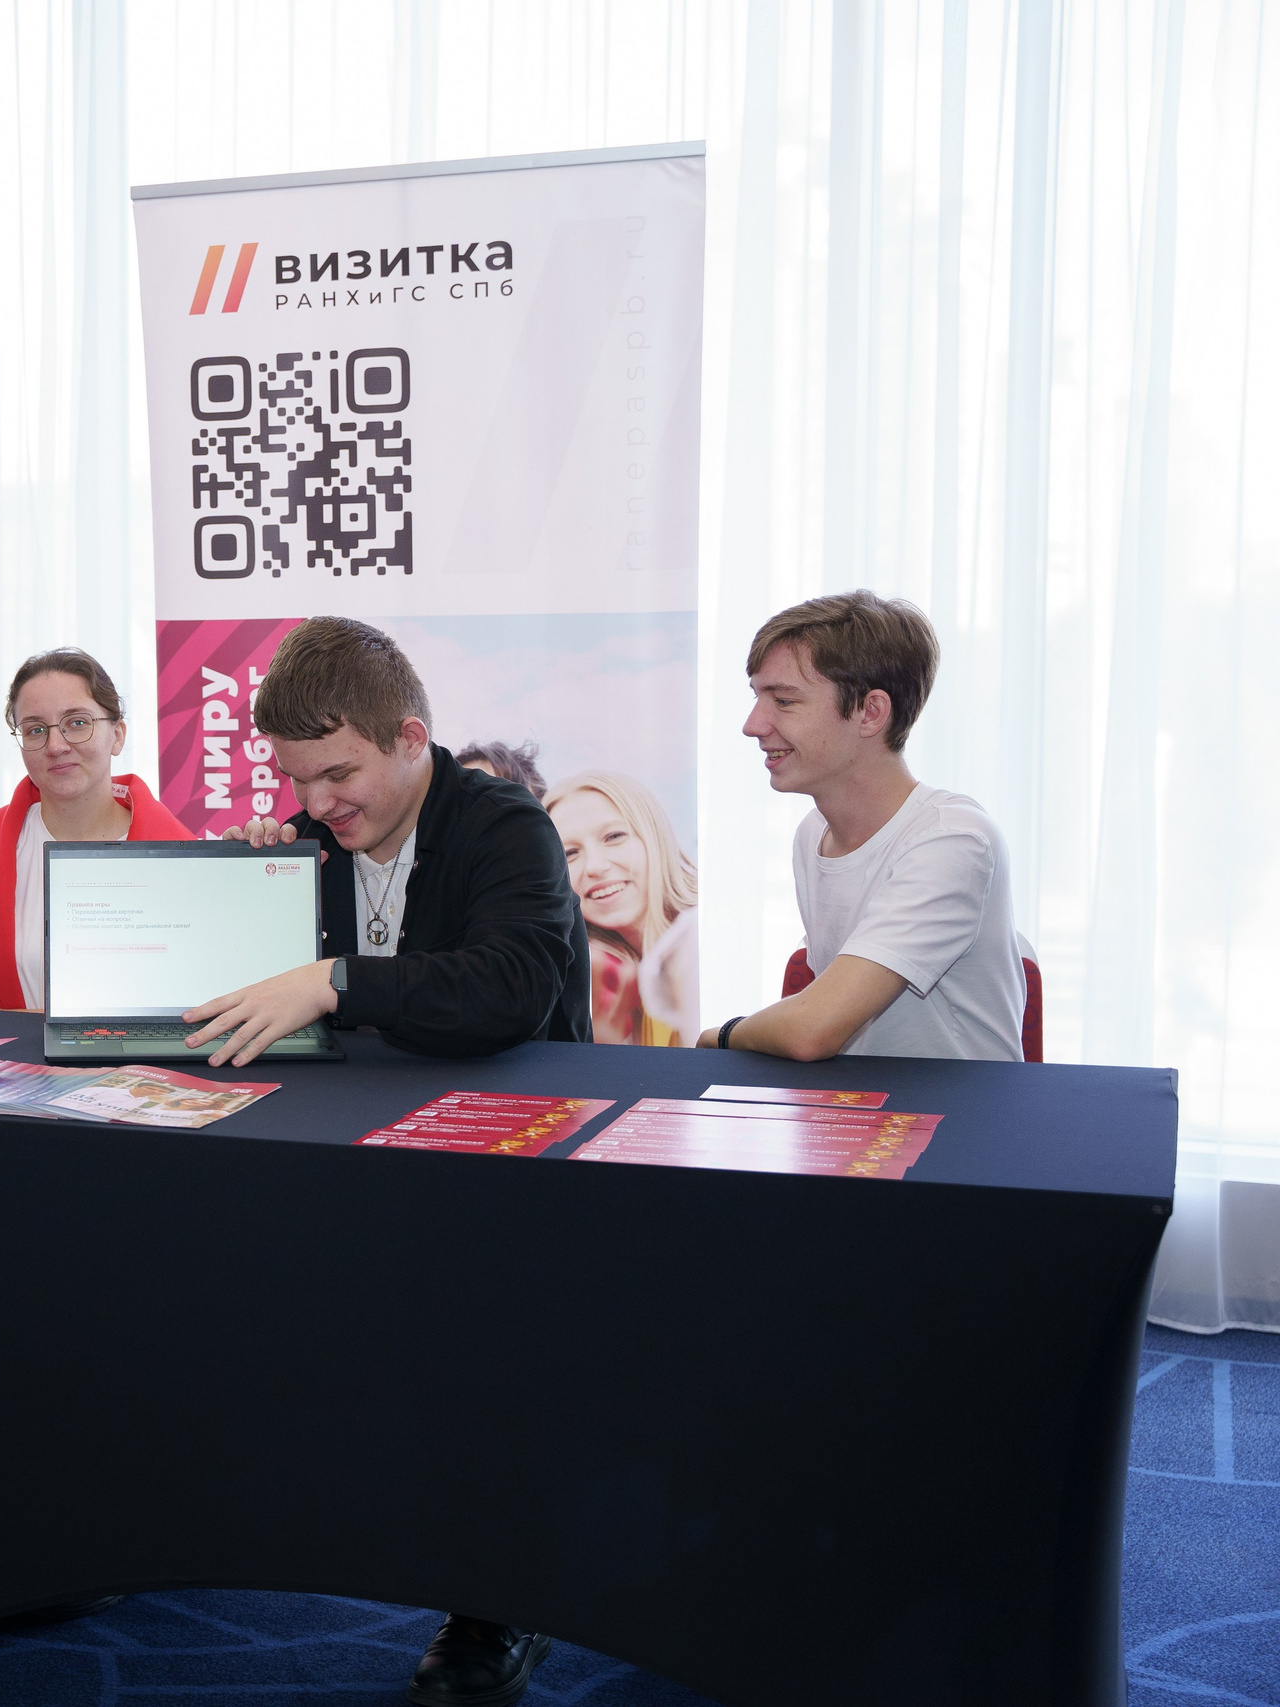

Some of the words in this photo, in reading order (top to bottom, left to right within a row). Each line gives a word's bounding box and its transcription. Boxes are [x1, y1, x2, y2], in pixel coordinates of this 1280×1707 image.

[275, 240, 513, 284] визитка
[276, 285, 426, 310] РАНХиГС
[449, 279, 513, 299] СПб
[619, 214, 651, 572] ranepaspb.ru
[201, 666, 239, 808] миру
